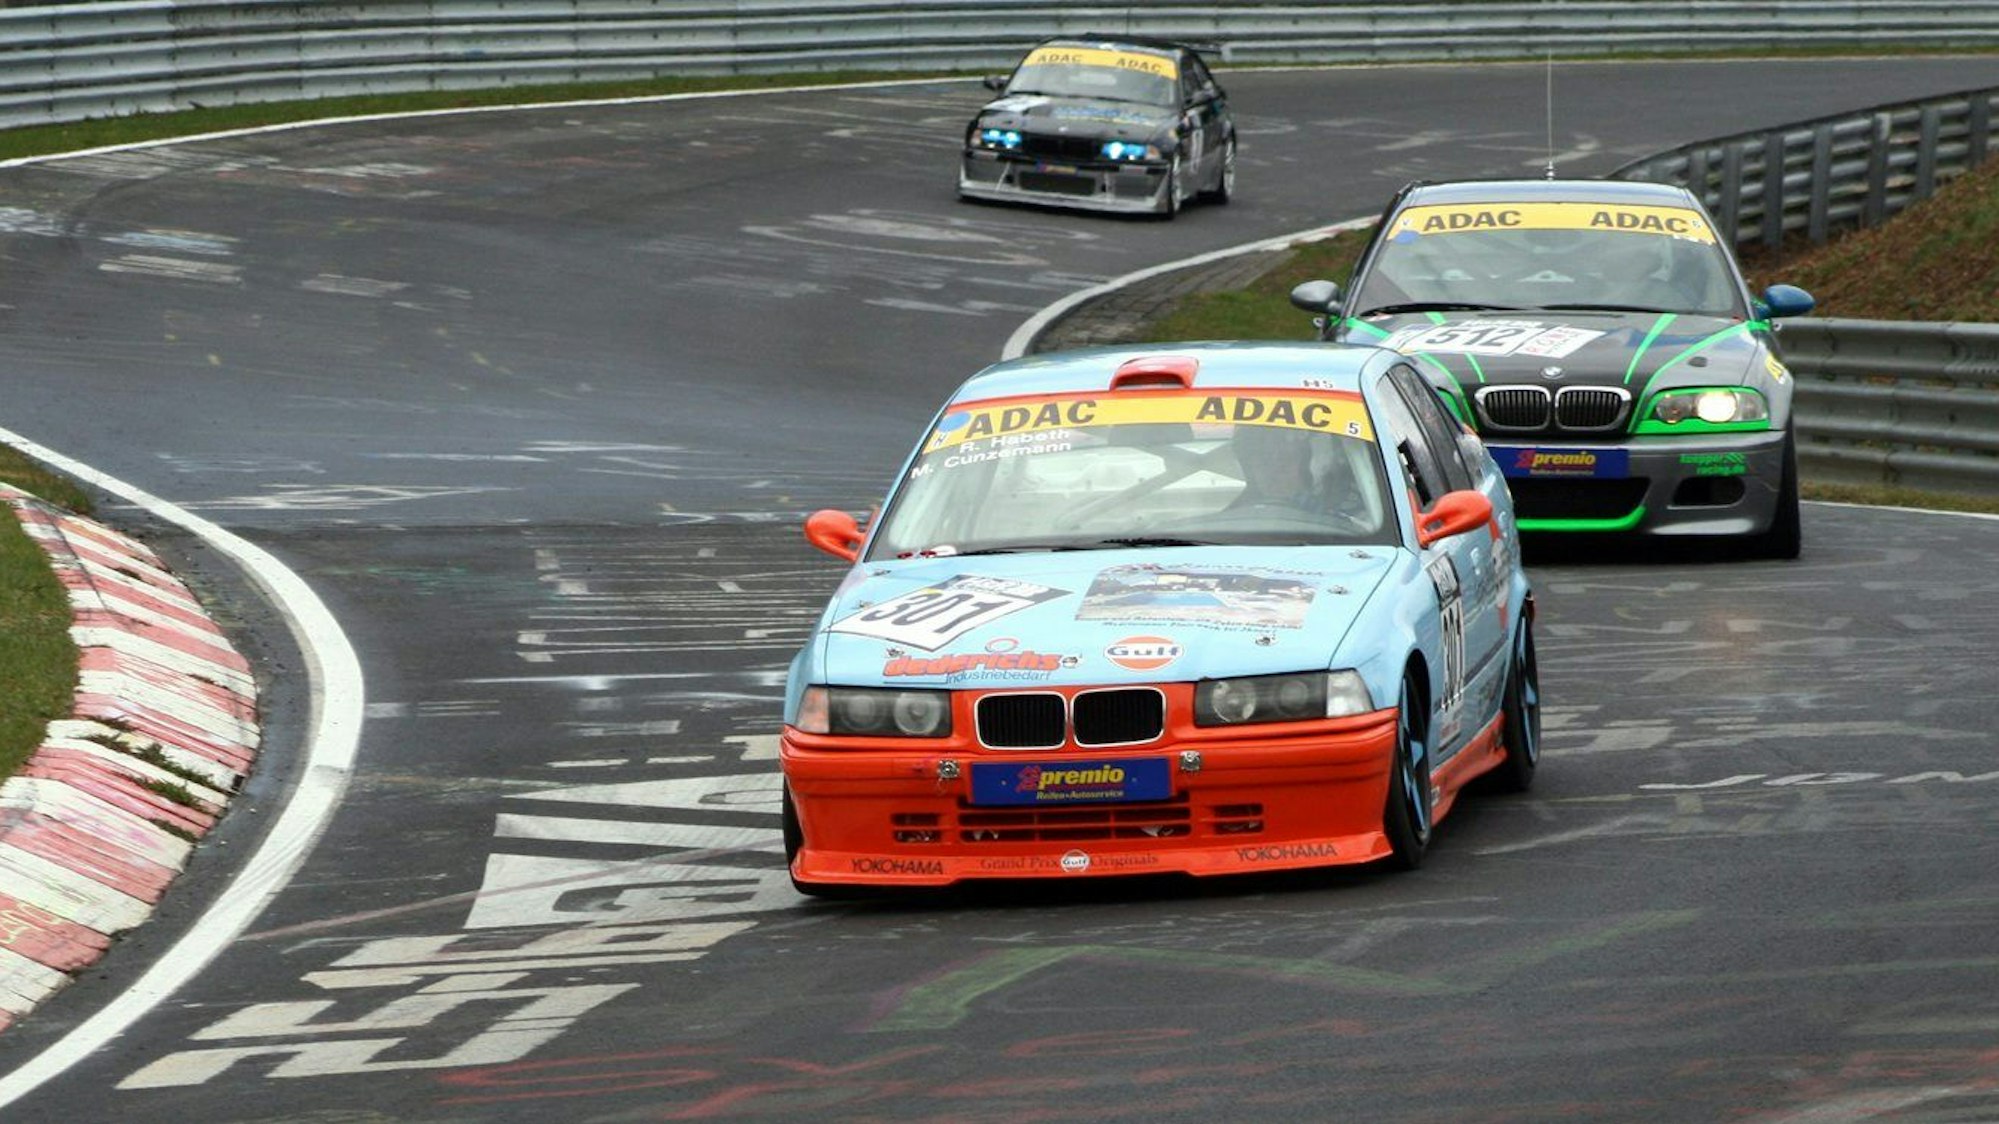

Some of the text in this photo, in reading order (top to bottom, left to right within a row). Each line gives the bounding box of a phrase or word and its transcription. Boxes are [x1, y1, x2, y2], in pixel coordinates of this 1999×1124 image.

[1036, 54, 1162, 72] ADAC ADAC
[1423, 210, 1522, 231] ADAC
[1590, 211, 1689, 233] ADAC
[1425, 327, 1524, 347] 512
[964, 399, 1097, 439] ADAC
[1195, 396, 1333, 428] ADAC
[1348, 422, 1360, 435] 5
[959, 429, 1070, 454] R. Habeth
[911, 442, 1072, 479] M. Cunzemann
[1532, 451, 1596, 468] premio
[860, 592, 1011, 634] 301
[1106, 645, 1181, 657] Gulf
[1037, 764, 1125, 790] premio
[1235, 842, 1339, 861] YOKOHAMA
[851, 853, 1160, 875] YOKOHAMA Grand Prix Gulf Originals
